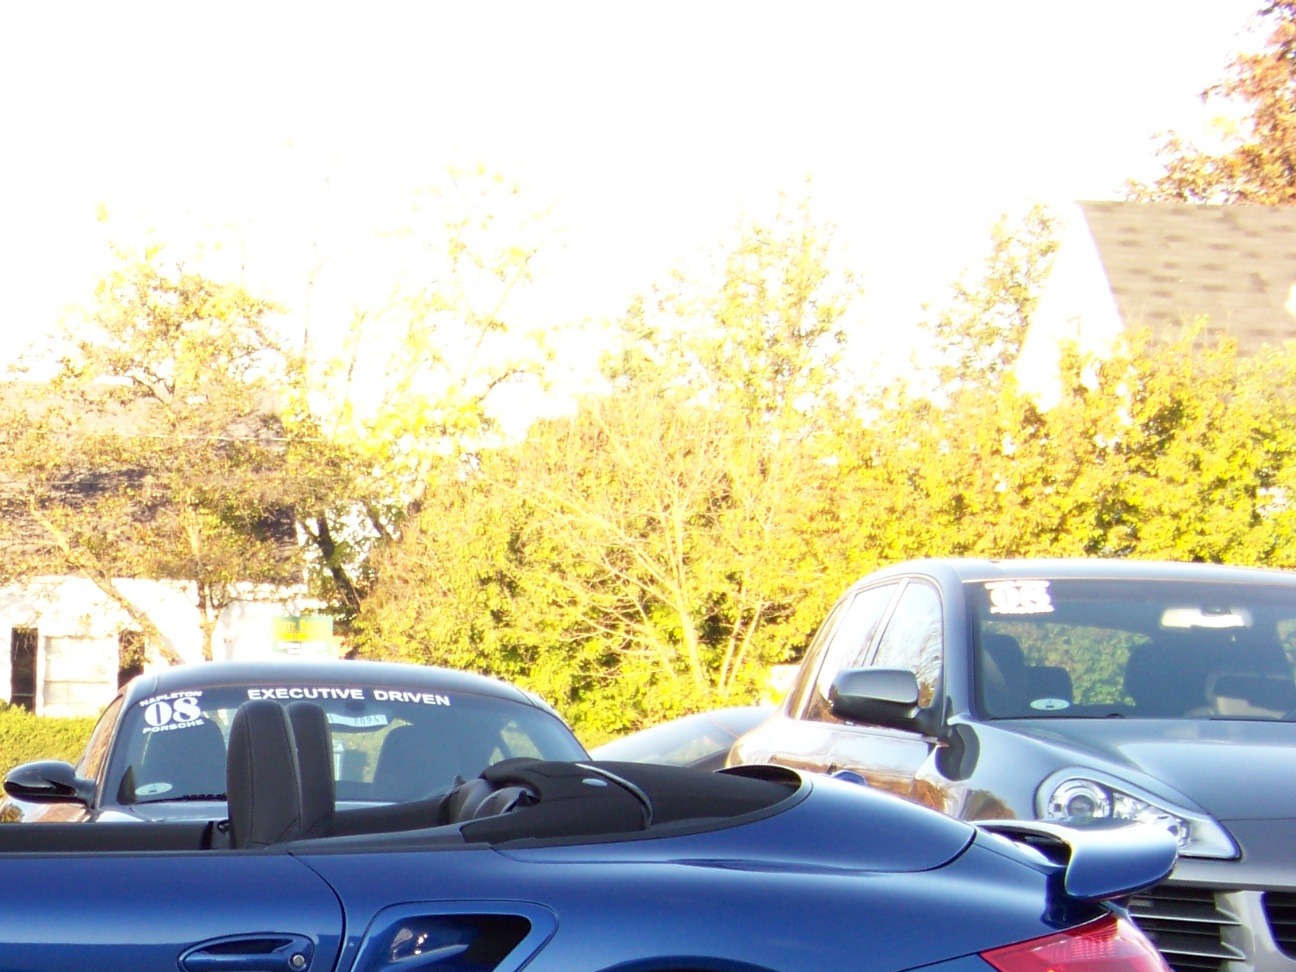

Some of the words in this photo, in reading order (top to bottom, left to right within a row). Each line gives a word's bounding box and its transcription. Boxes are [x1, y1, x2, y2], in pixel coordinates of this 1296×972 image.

[139, 690, 203, 707] NAPLETON
[247, 688, 365, 700] EXECUTIVE
[373, 690, 450, 706] DRIVEN
[145, 697, 201, 727] 08
[142, 719, 205, 734] PORSCHE
